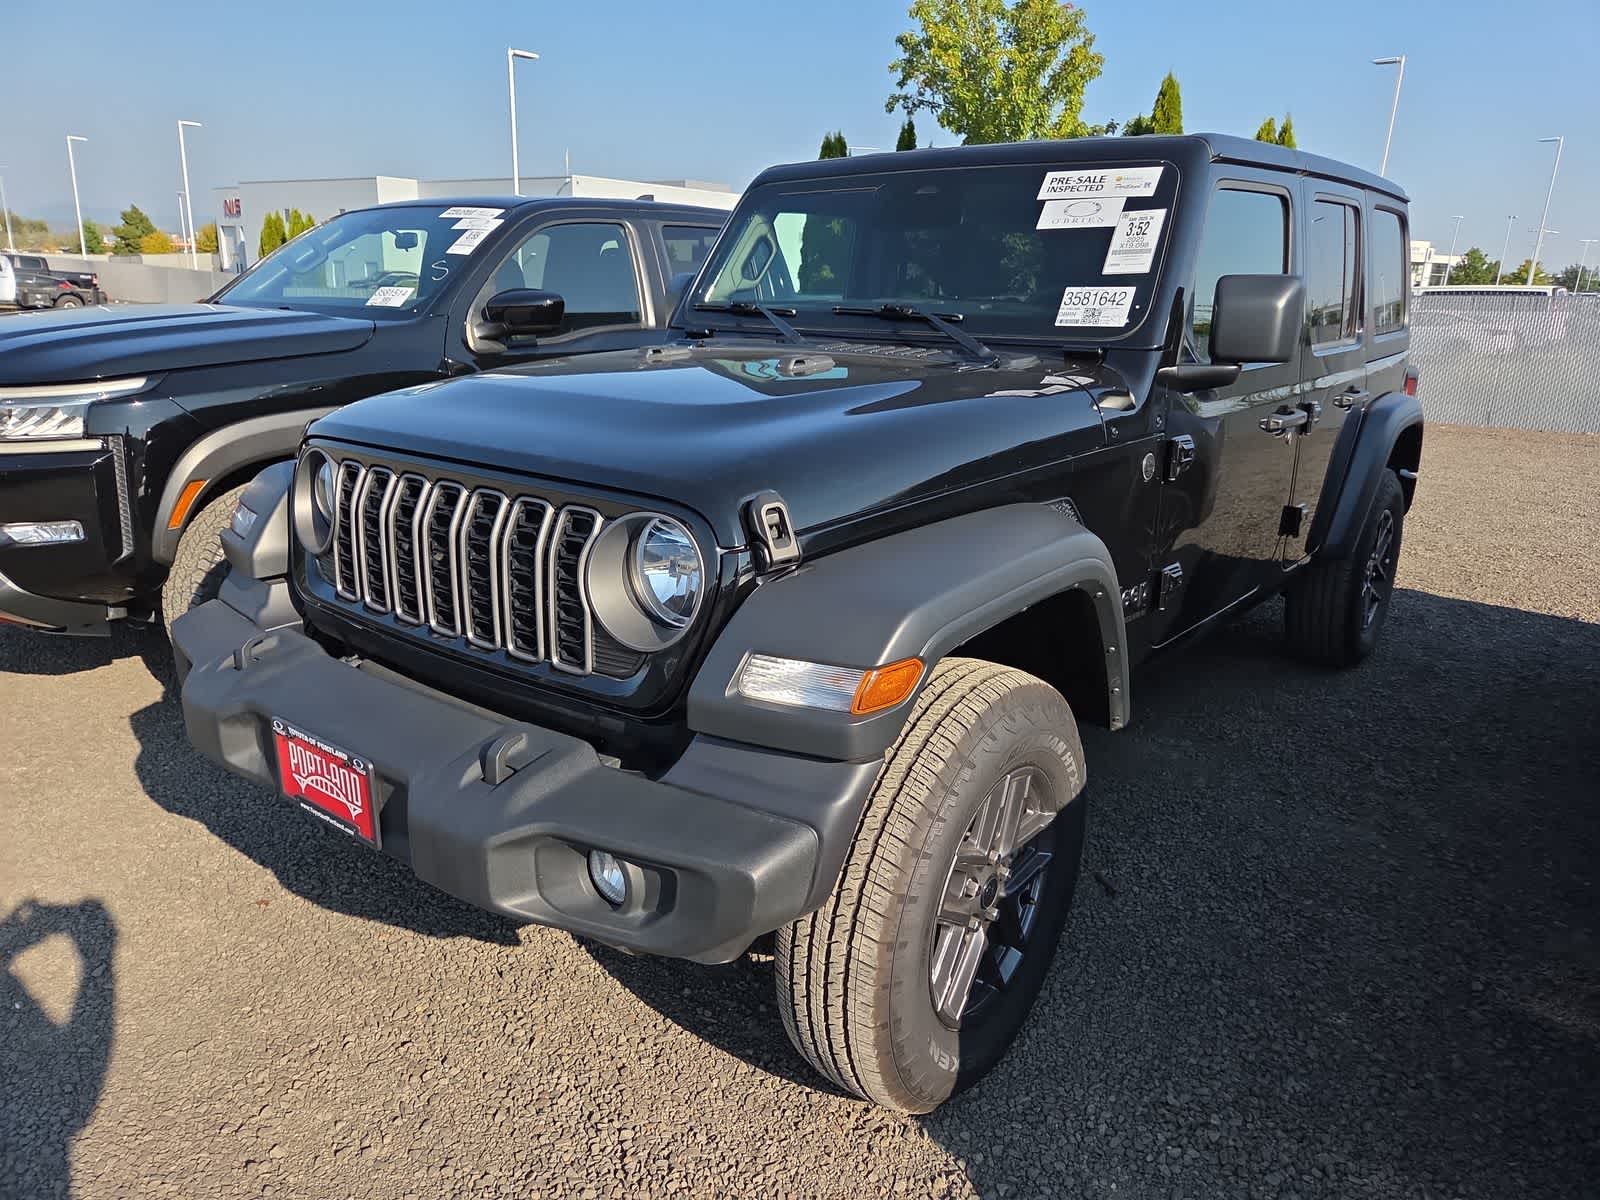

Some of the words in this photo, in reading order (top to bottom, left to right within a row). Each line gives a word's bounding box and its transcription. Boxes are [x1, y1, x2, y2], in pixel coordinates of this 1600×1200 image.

[1049, 175, 1107, 186] PRE-SALE
[1046, 184, 1104, 193] INSPECTED
[1126, 221, 1150, 237] 3:52
[431, 260, 449, 281] S
[1063, 291, 1127, 306] 3581642
[288, 740, 362, 807] PORTLAND
